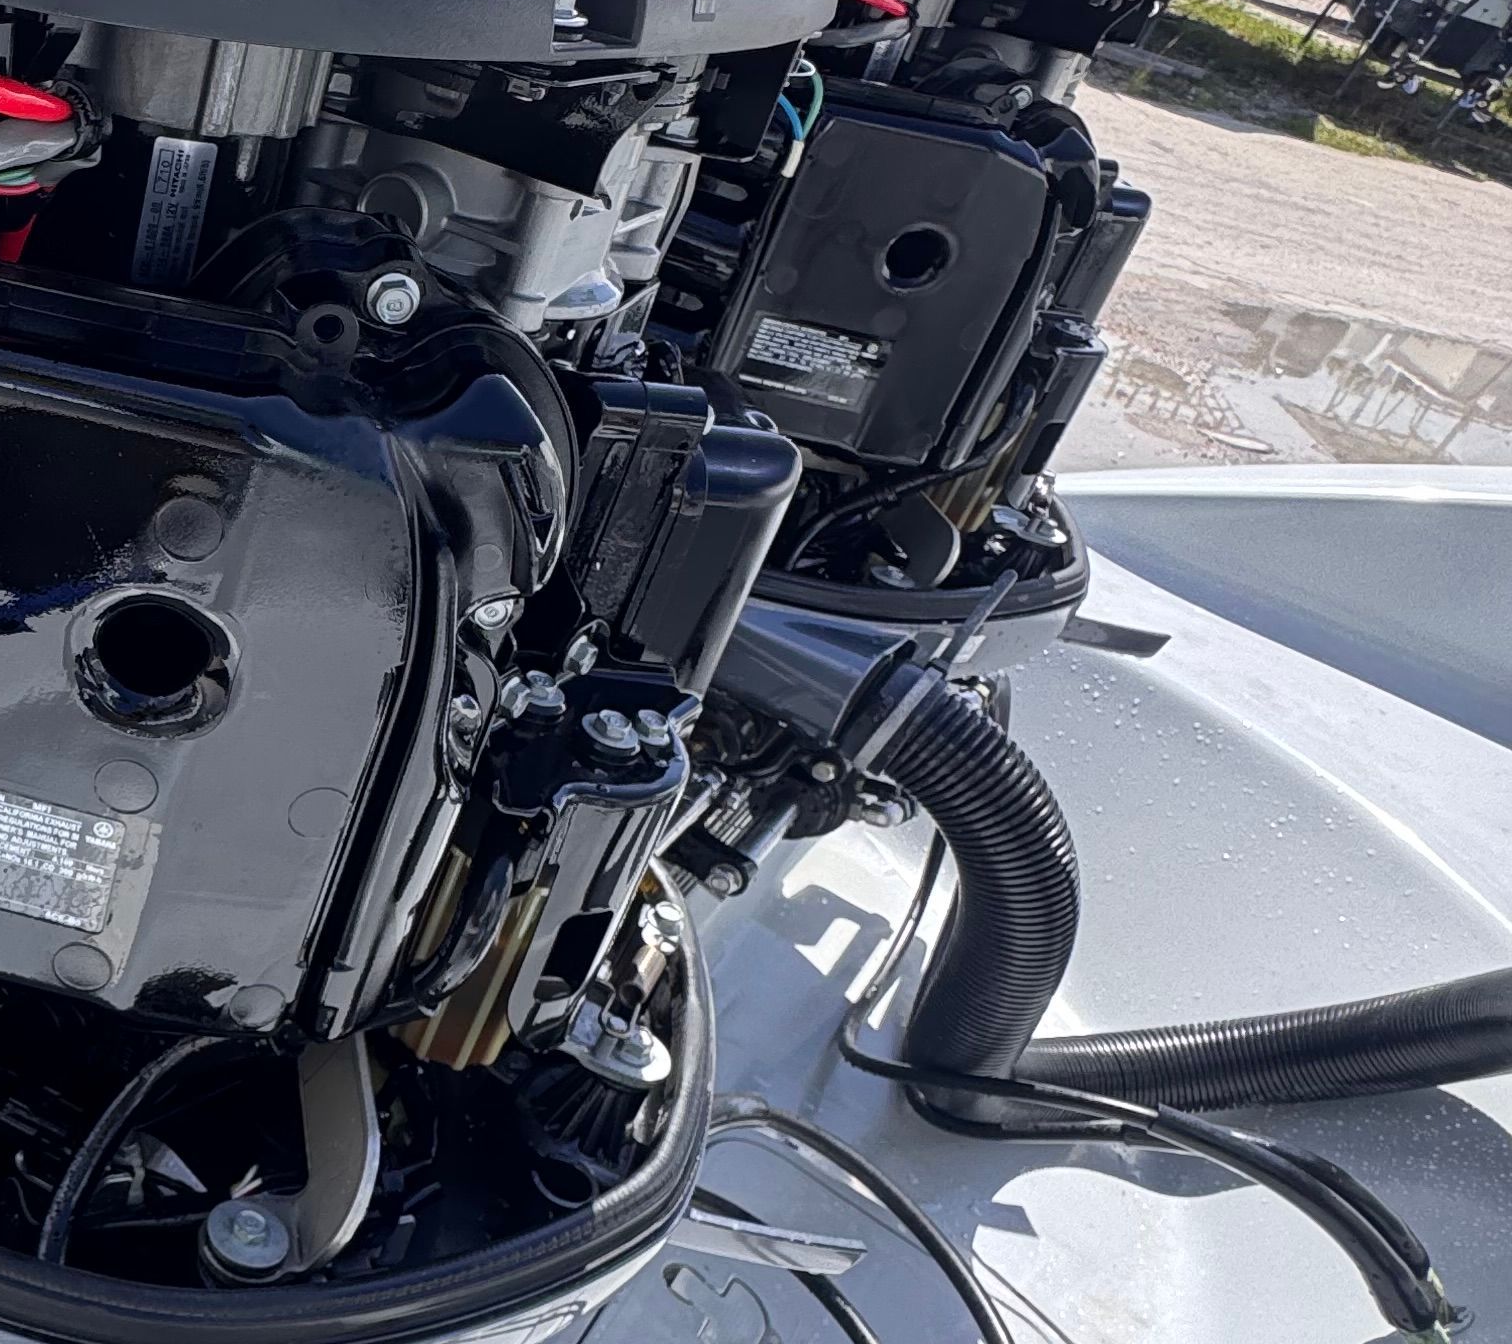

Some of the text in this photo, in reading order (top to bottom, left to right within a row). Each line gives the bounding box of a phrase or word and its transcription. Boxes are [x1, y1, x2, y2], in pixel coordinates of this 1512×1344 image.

[157, 159, 171, 183] 710
[169, 149, 184, 197] HITACHI
[44, 815, 81, 832] EXHAUST
[52, 826, 70, 838] FOR
[26, 829, 60, 845] MANUAL
[59, 837, 77, 849] FOR
[83, 834, 116, 849] YAMAHA
